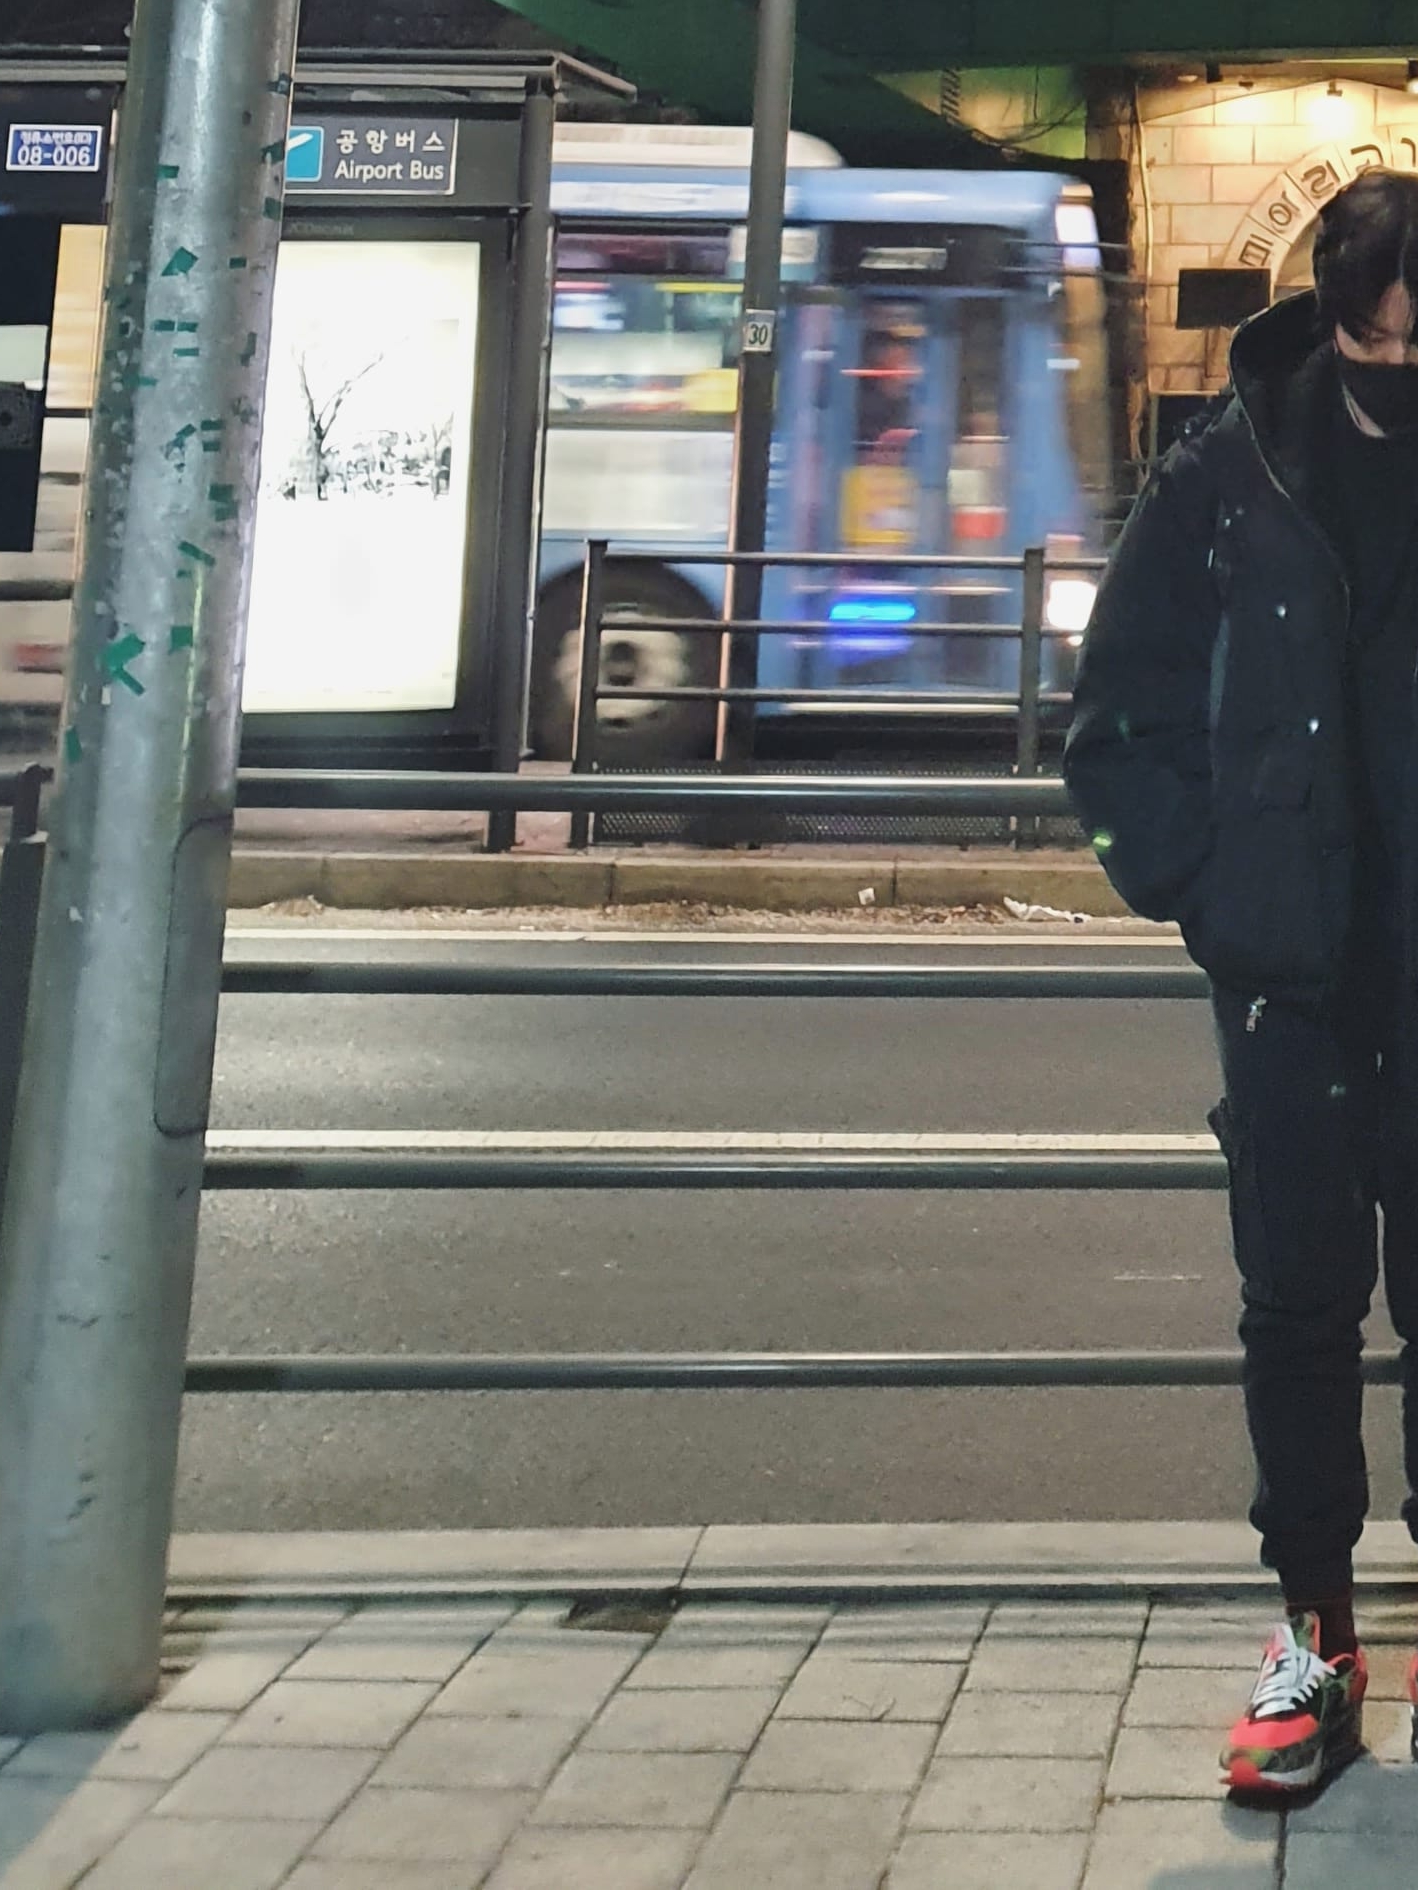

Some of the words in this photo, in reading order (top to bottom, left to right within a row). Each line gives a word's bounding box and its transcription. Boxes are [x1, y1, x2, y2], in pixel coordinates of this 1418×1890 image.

[336, 129, 446, 154] 공항버스
[17, 145, 91, 166] 08-006
[334, 160, 402, 183] Airport
[410, 160, 444, 180] Bus
[749, 323, 769, 346] 30
